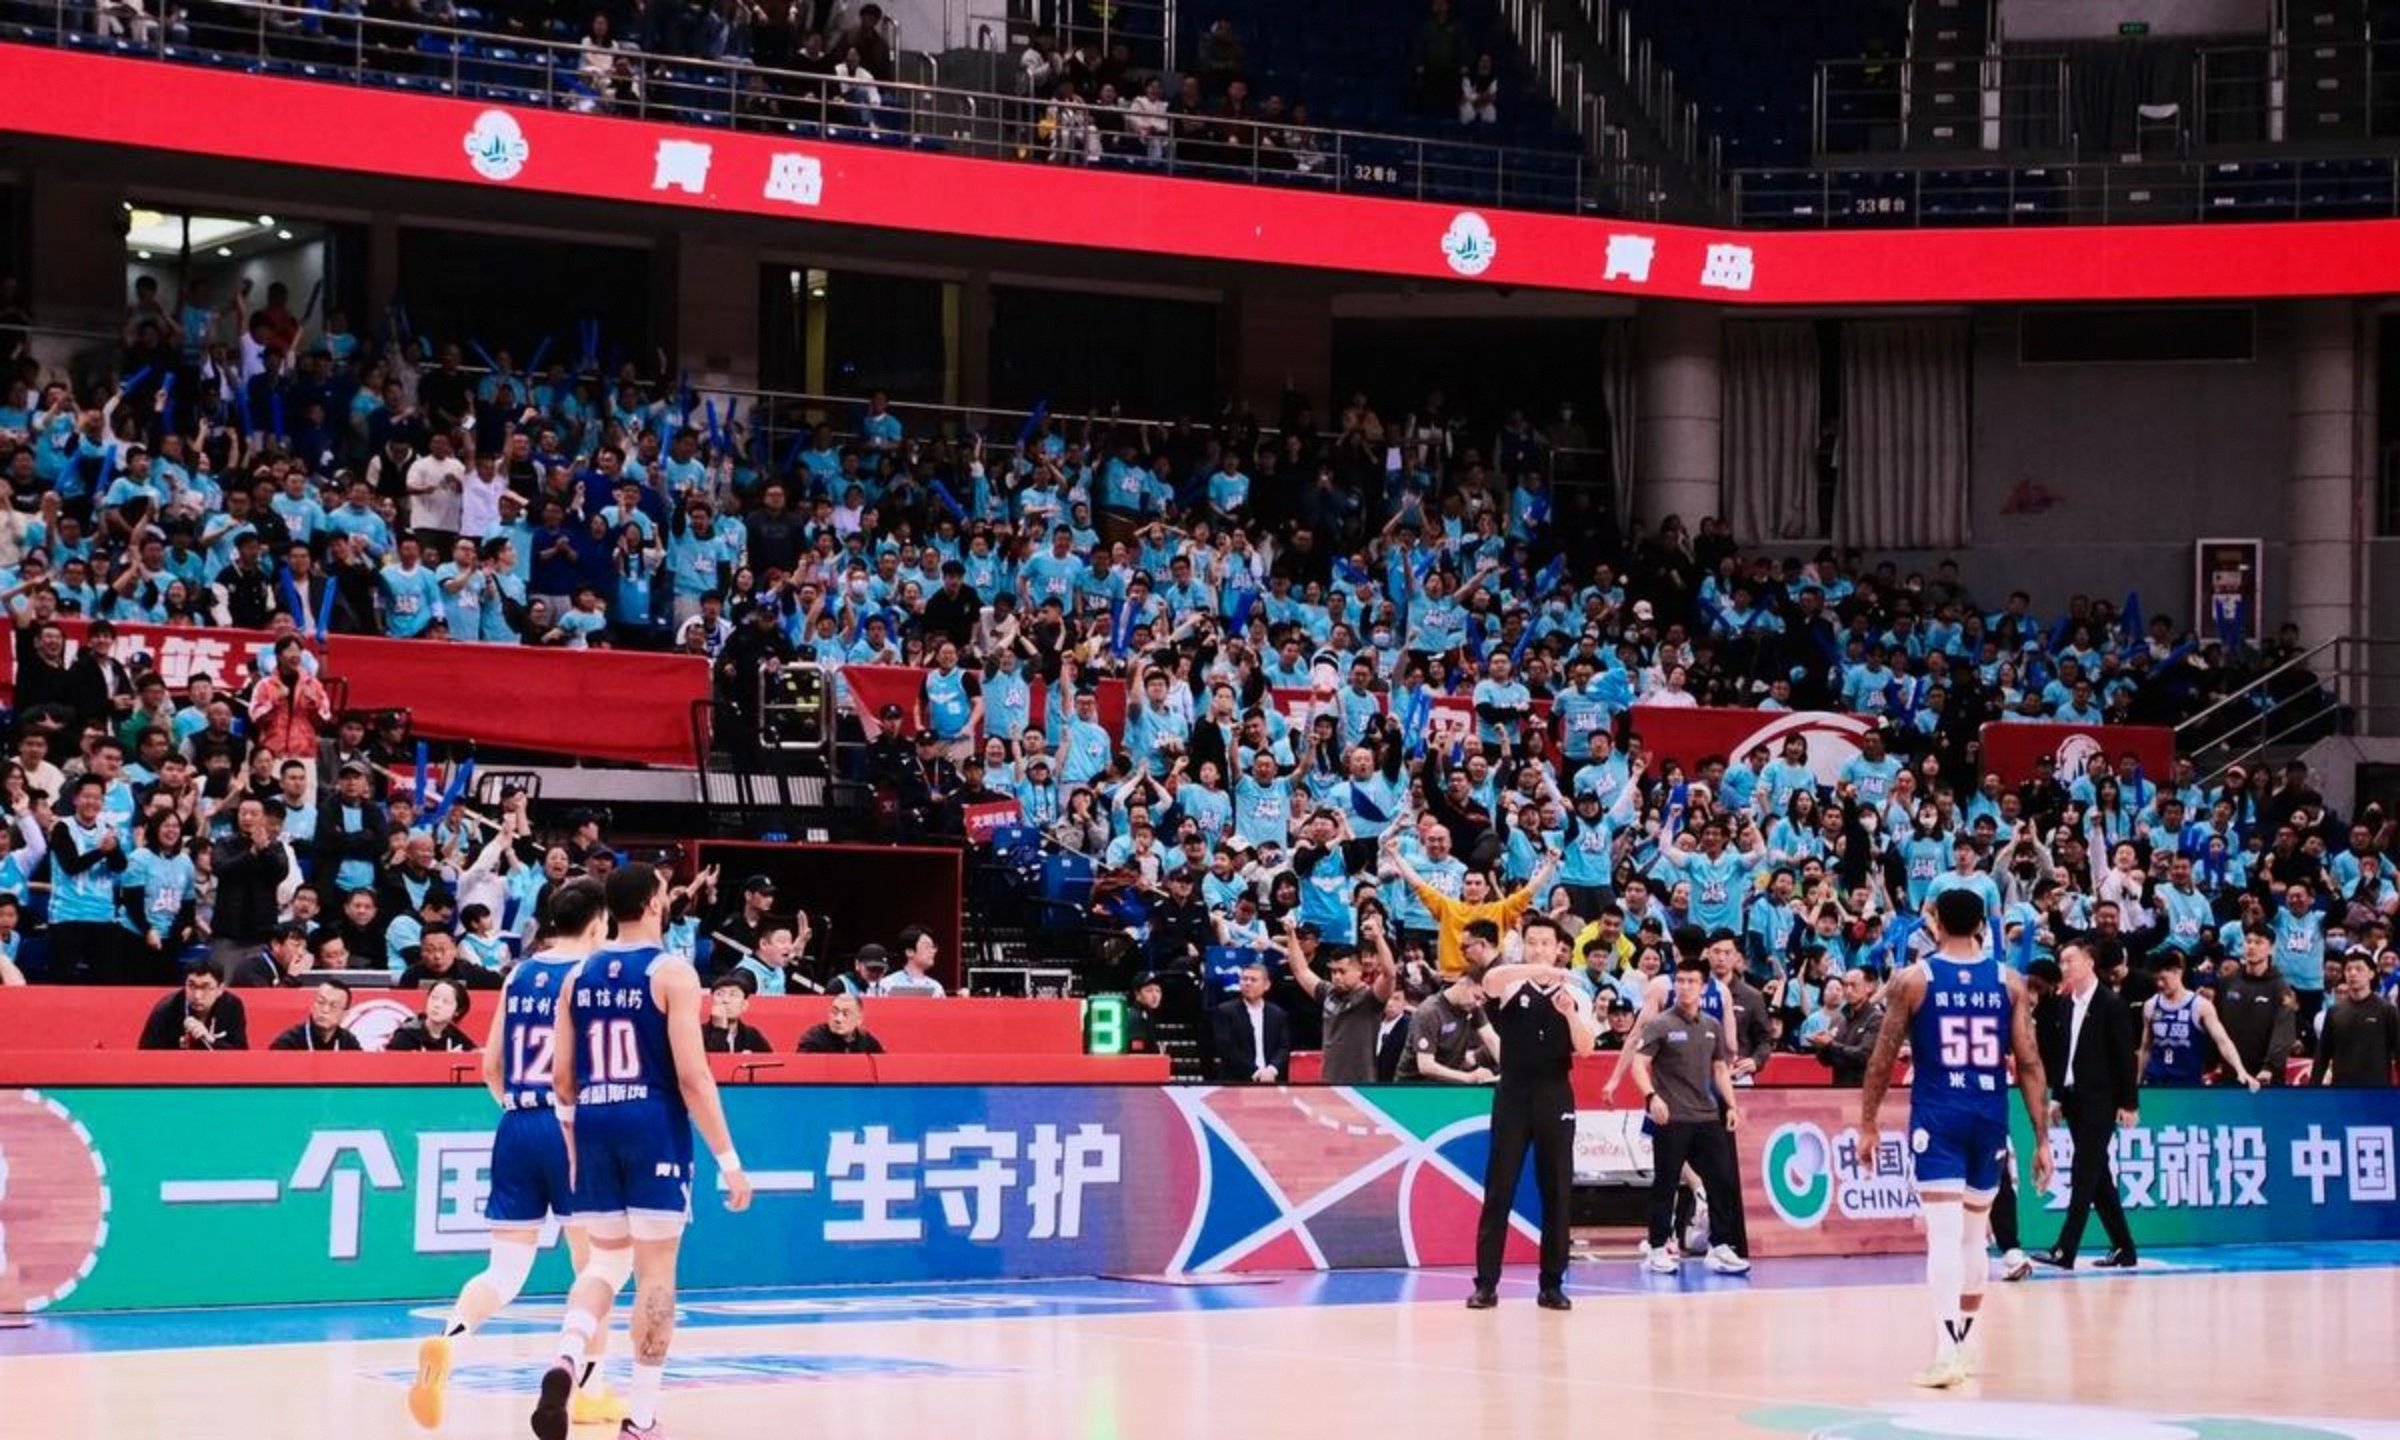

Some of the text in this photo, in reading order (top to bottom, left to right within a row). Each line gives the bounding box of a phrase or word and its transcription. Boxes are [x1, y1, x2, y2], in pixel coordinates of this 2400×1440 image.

[1354, 165, 1397, 183] 32看台
[1856, 197, 1905, 214] 33看台
[511, 1023, 555, 1085] 12
[588, 1018, 641, 1083] 10
[1939, 1015, 1999, 1068] 55
[717, 1123, 1120, 1241] 一生守护
[2291, 1123, 2396, 1204] 中国
[1843, 1187, 1919, 1210] CHINA
